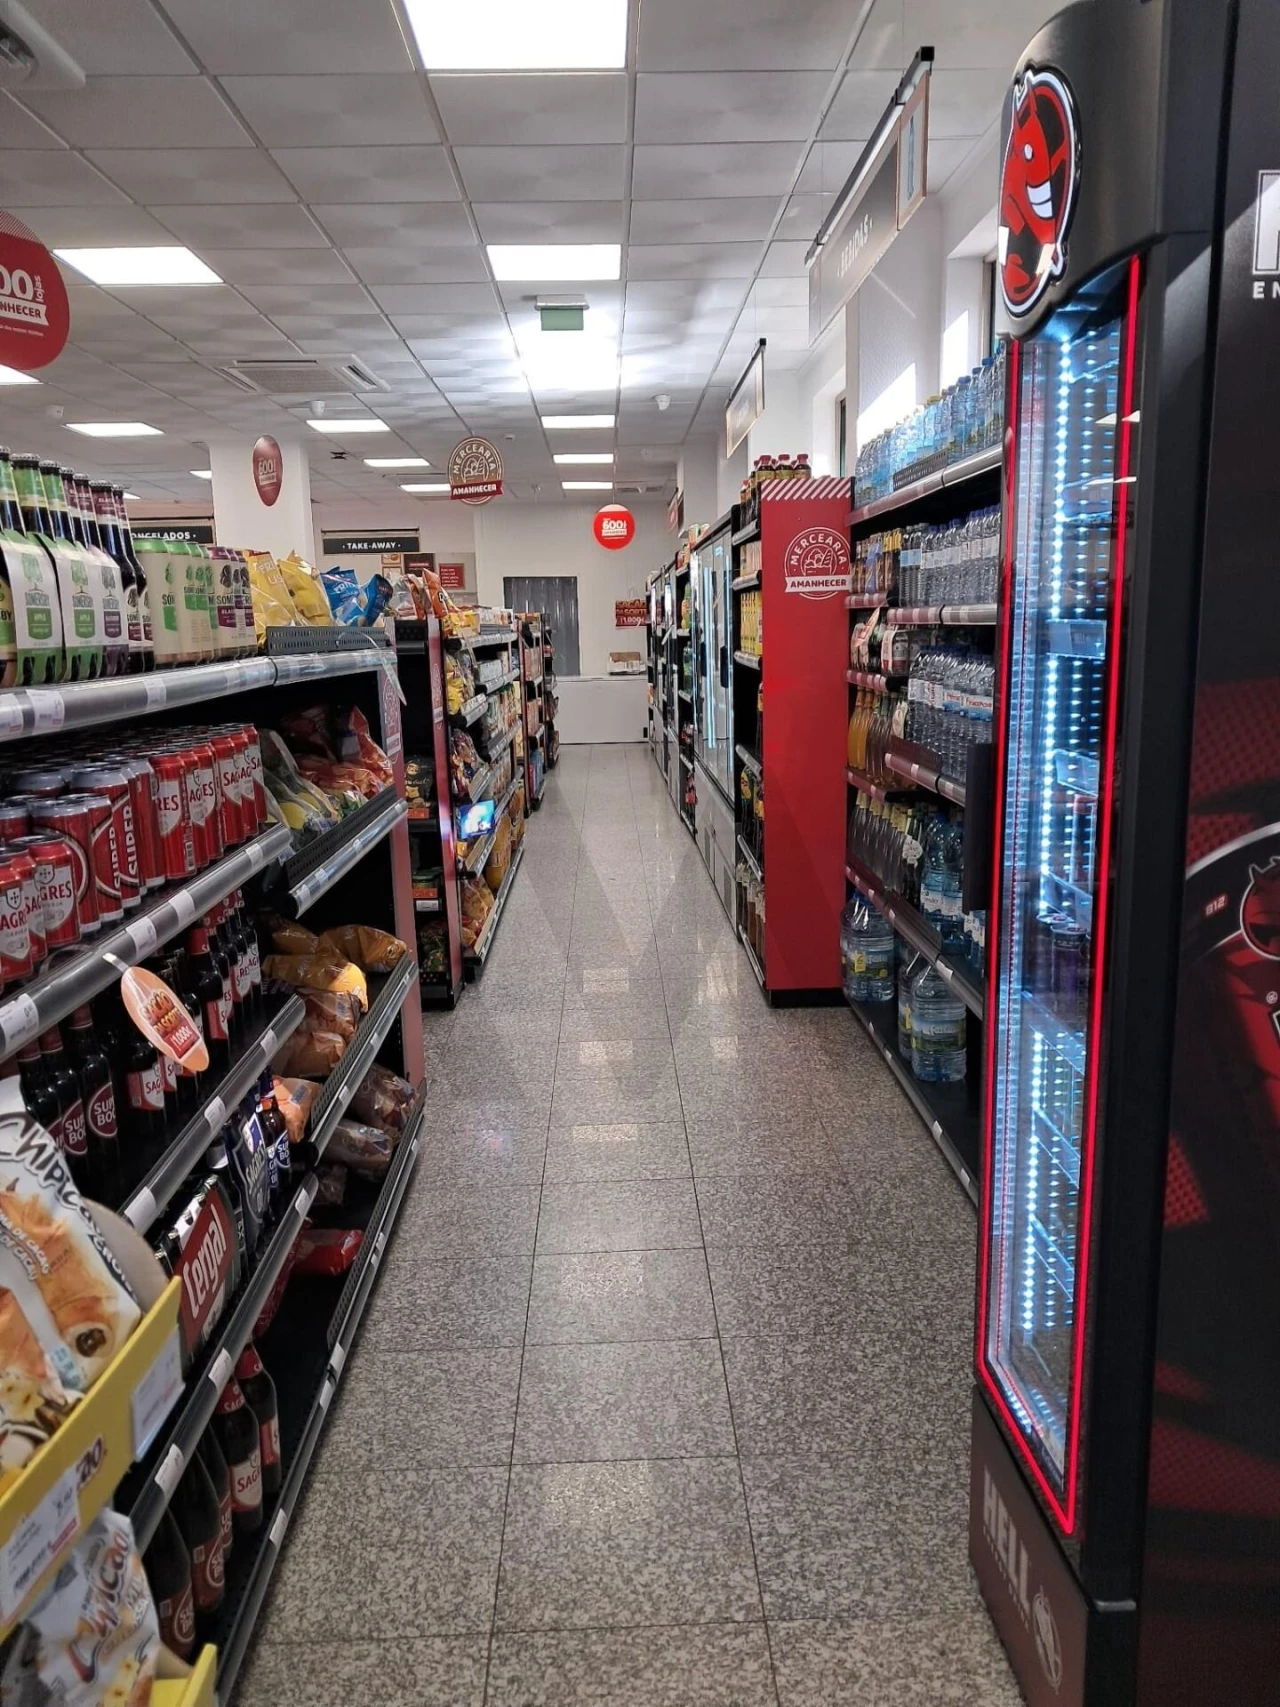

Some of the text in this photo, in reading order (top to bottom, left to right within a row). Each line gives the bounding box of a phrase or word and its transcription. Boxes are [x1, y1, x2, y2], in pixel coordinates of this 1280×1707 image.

[453, 444, 497, 475] MERCEARIA
[453, 483, 497, 496] AMANHECER
[347, 542, 396, 550] TAKE-AWAY
[790, 533, 847, 566] MERCEARIA
[790, 578, 847, 589] AMANHECER
[983, 1464, 1030, 1619] HELL
